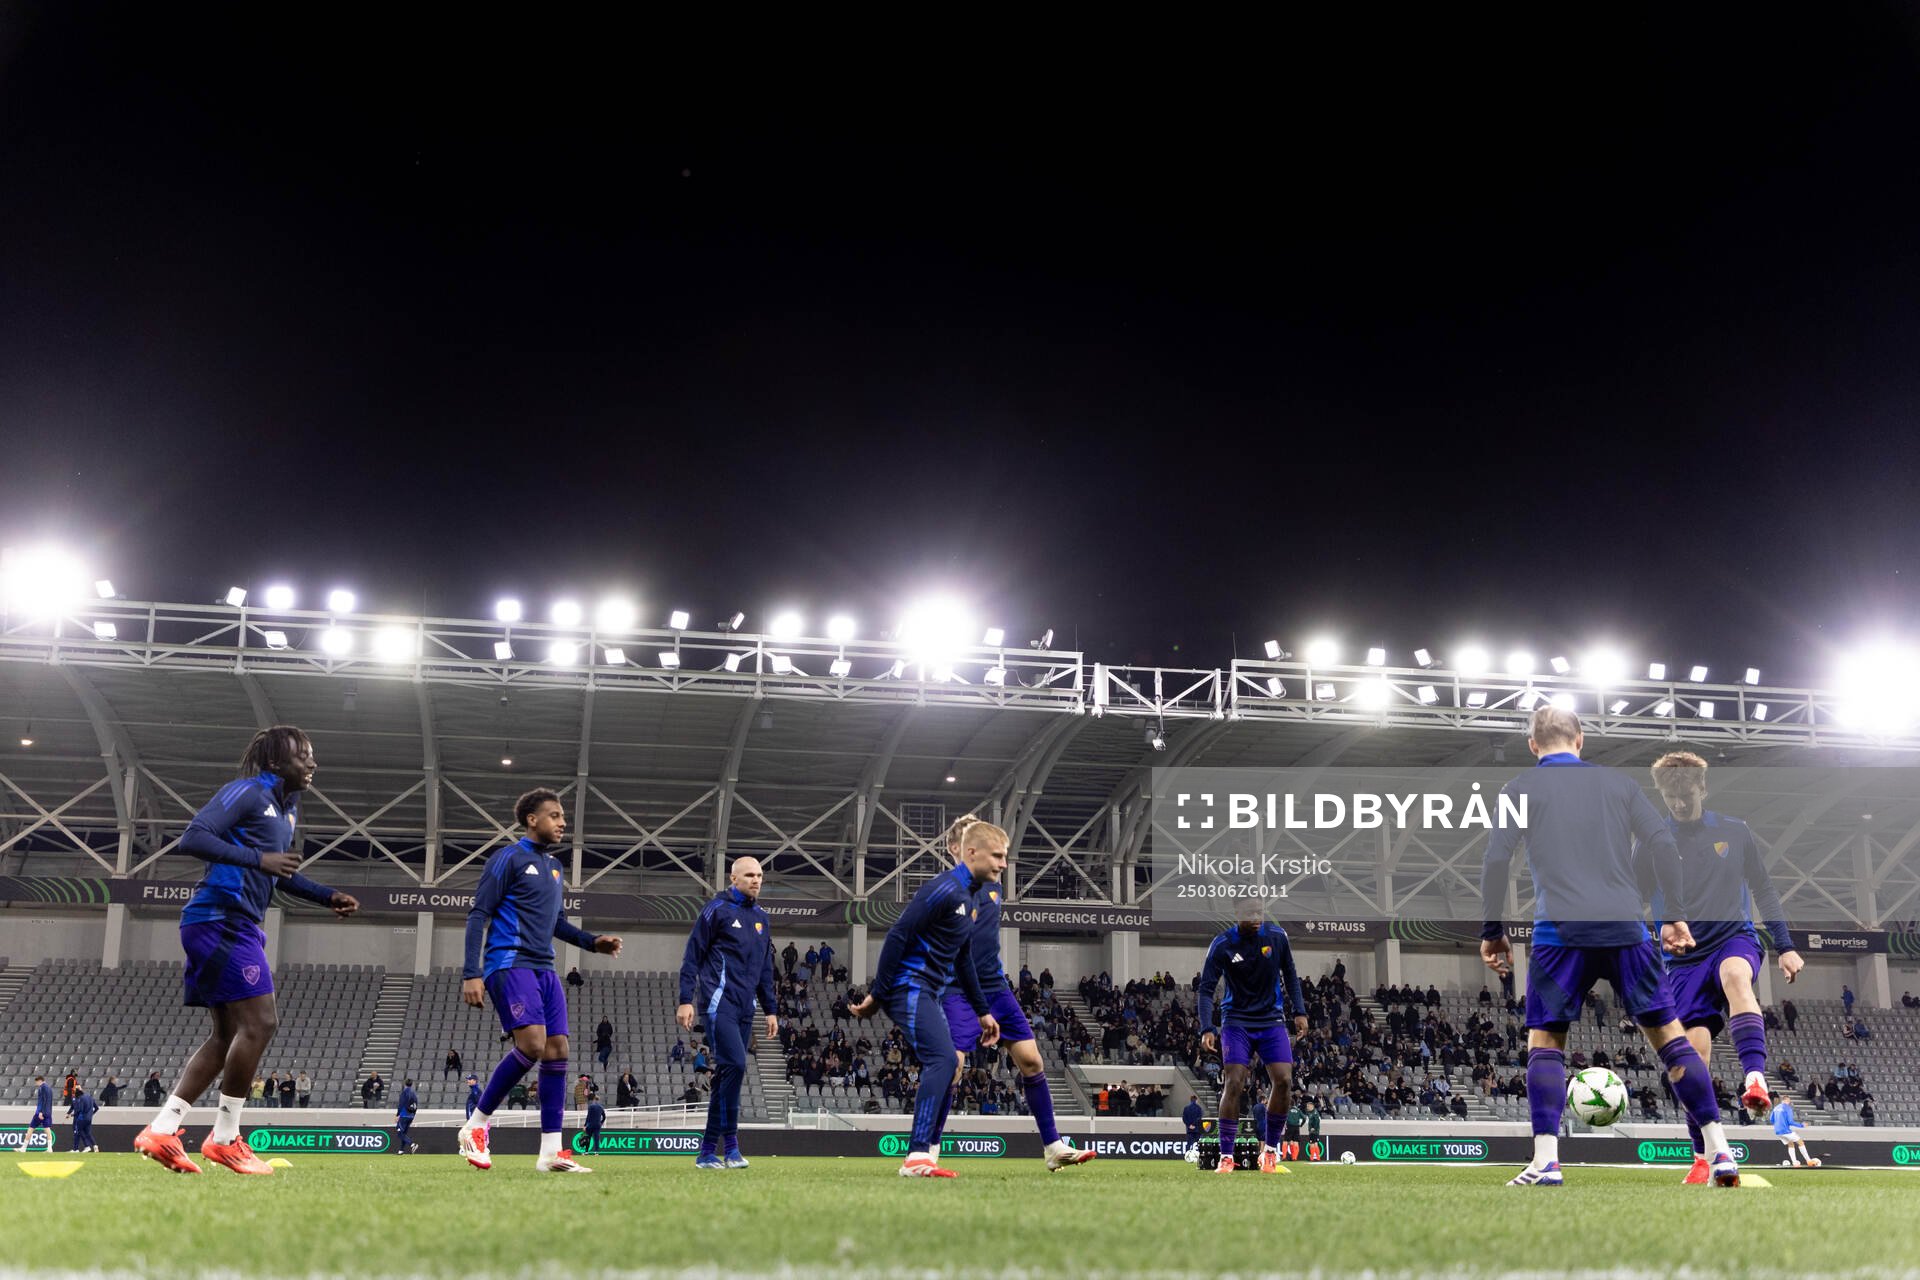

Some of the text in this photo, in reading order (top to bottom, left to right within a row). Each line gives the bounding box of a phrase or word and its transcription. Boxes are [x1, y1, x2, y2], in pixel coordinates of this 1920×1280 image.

[389, 893, 426, 906] UEFA
[1013, 911, 1097, 924] CONFERENCE
[1101, 914, 1150, 926] LEAGUE
[1318, 921, 1366, 932] STRAUSS
[1808, 934, 1868, 948] enterprise
[272, 1135, 383, 1148] MAKE IT YOURS
[640, 1137, 653, 1149] IT
[655, 1137, 700, 1149] YOURS
[957, 1140, 1000, 1153] YOURS
[1085, 1141, 1126, 1154] UEFA
[1392, 1144, 1482, 1156] MAKE IT YOURS
[1656, 1146, 1691, 1157] MAKE
